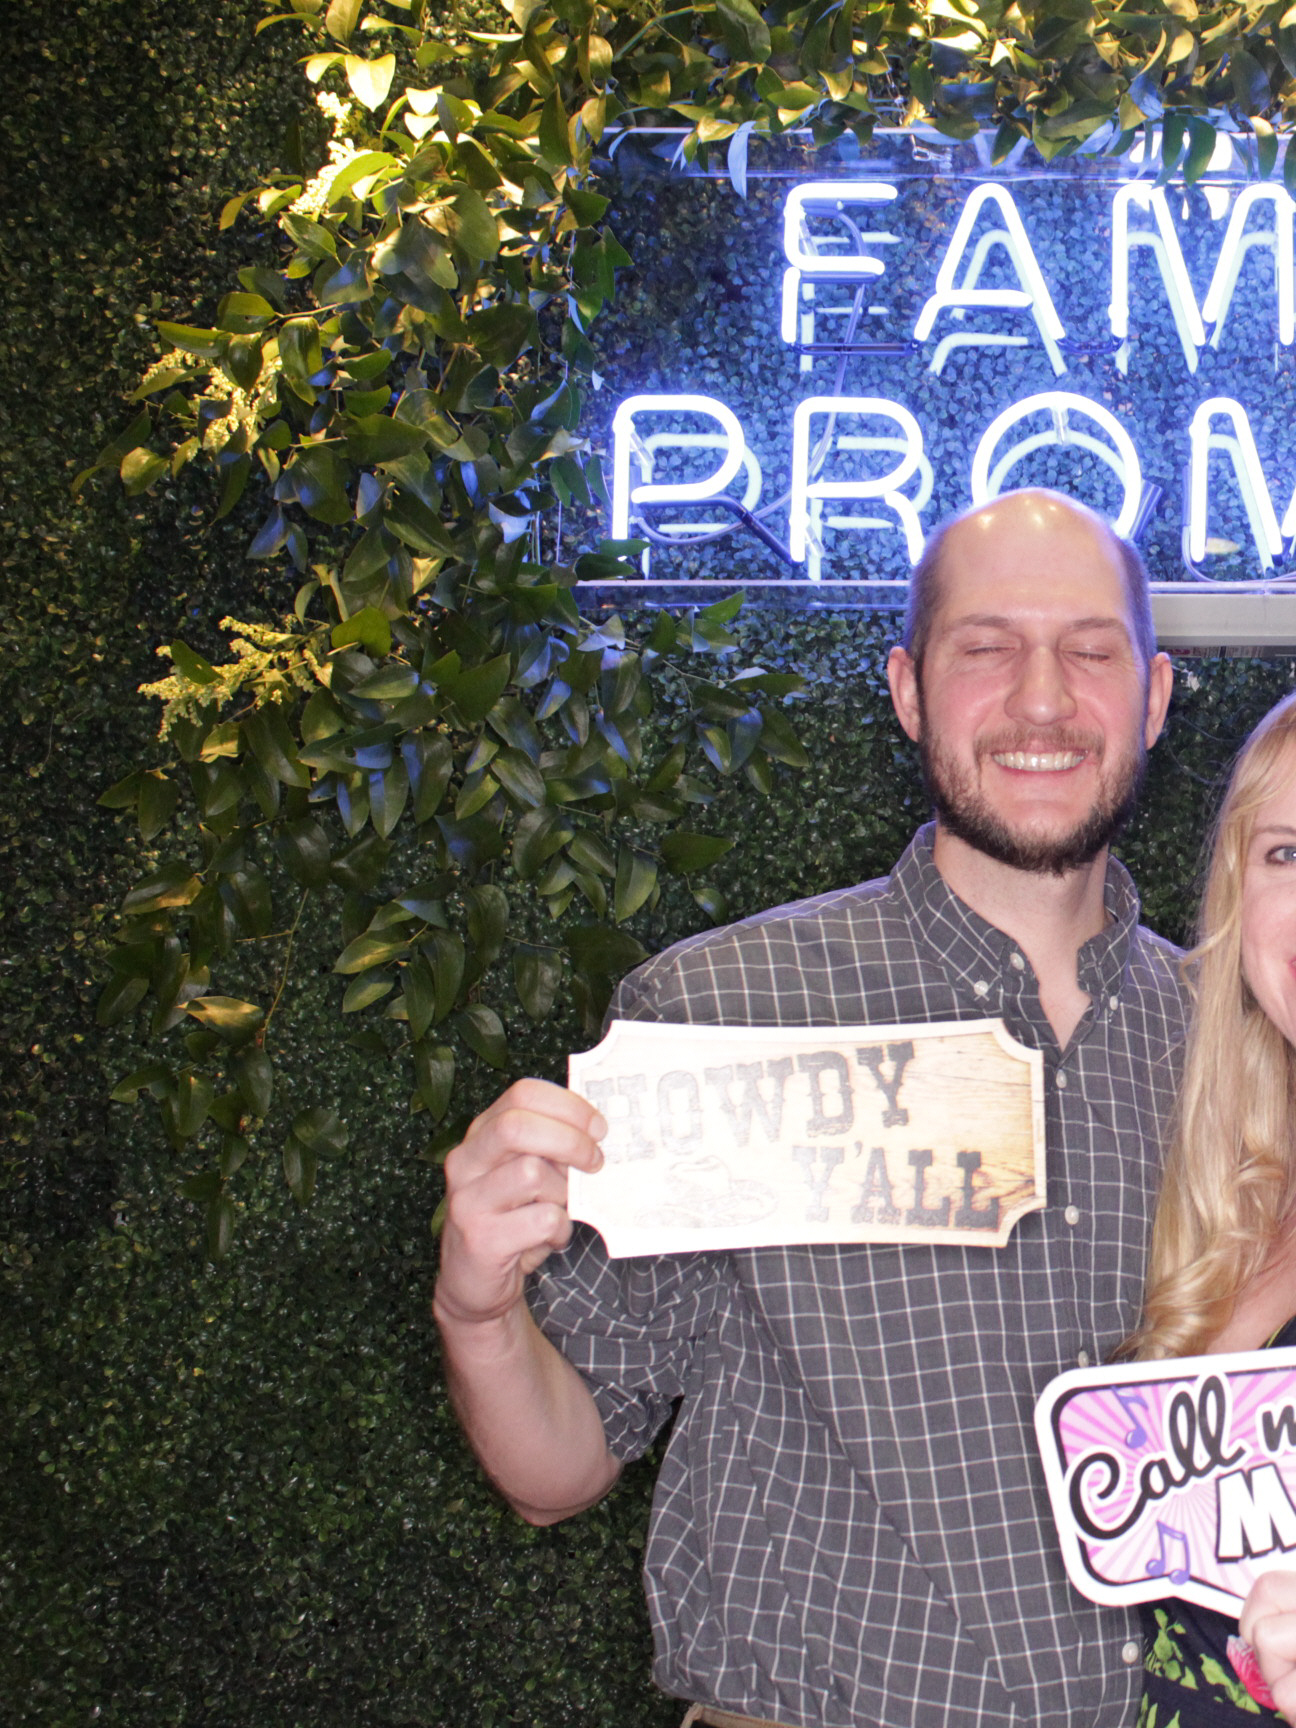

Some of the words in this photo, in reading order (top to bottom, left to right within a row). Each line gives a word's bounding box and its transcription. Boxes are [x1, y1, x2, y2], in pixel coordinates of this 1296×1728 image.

[585, 1041, 915, 1164] HOWDY
[792, 1140, 999, 1229] Y'ALL
[1069, 1375, 1245, 1540] Call
